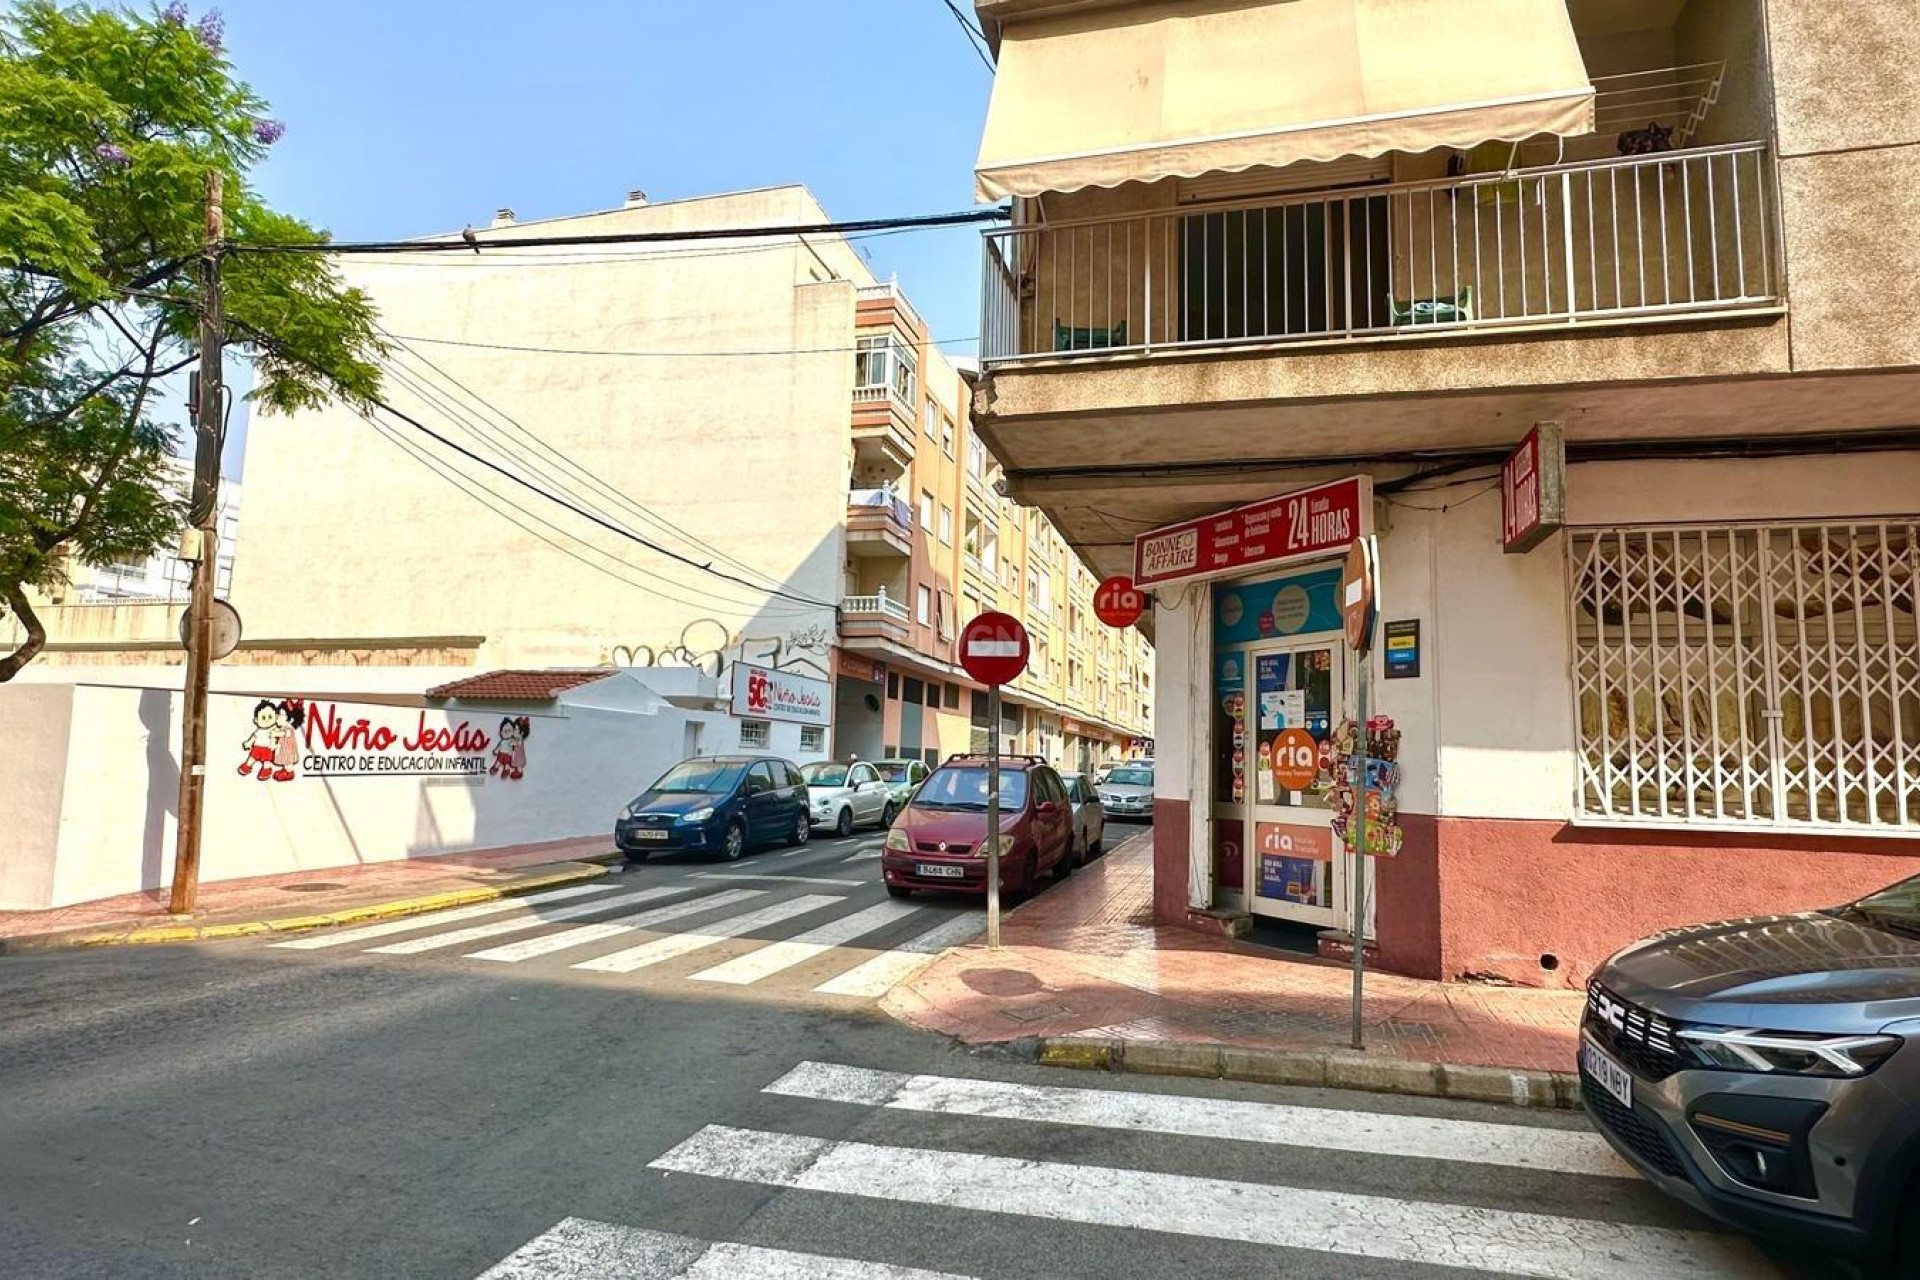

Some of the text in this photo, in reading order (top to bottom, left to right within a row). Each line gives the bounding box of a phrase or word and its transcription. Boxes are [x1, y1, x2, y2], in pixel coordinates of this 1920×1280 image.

[1288, 496, 1310, 550] 24
[1311, 507, 1351, 546] HORAS
[1145, 534, 1183, 557] BONNE
[1146, 547, 1196, 571] AFFAIRE
[1099, 583, 1138, 610] ria
[305, 702, 491, 752] Niño Jesús
[303, 752, 487, 771] CENTRO DE EDUCACIÓN INFANTIL
[1276, 735, 1313, 768] ria
[1265, 827, 1293, 851] ria
